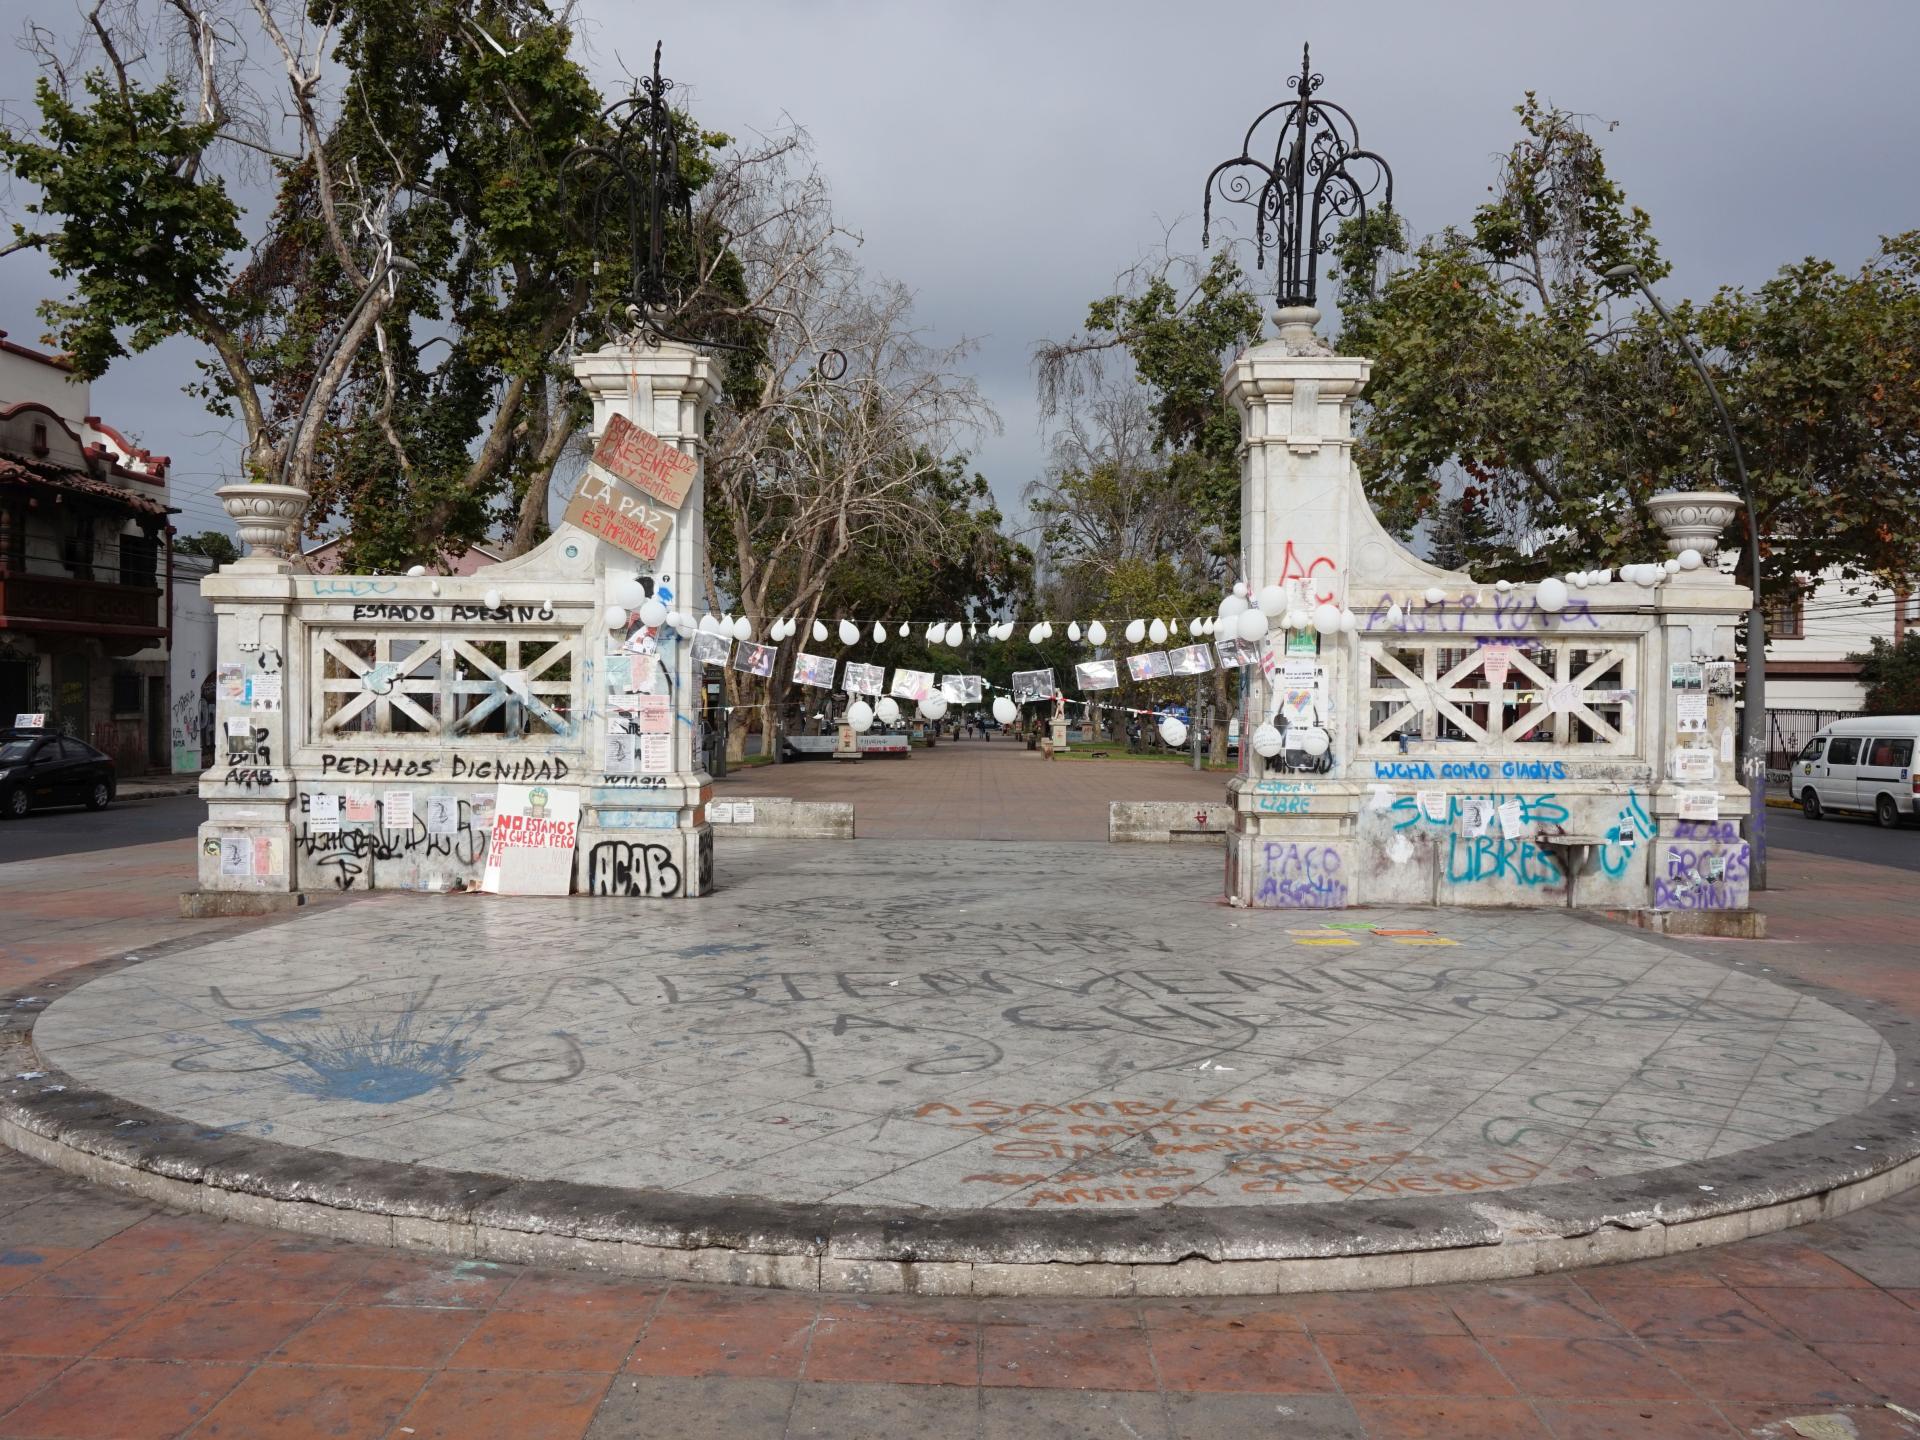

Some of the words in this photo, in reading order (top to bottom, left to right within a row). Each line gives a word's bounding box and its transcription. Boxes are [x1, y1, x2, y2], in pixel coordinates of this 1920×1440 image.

[604, 430, 673, 484] PRESENTE
[580, 475, 611, 505] LA
[619, 496, 661, 532] PAZ
[597, 504, 616, 520] SIN
[581, 510, 602, 529] ES
[602, 520, 657, 560] IMPUNIDAD
[353, 603, 435, 622] ESTADO
[451, 604, 554, 622] ASESINO
[322, 754, 435, 777] PEDIMOS
[451, 754, 570, 781] DIGNIDAD
[1375, 761, 1436, 780] LUCHA
[1441, 762, 1489, 780] COMO
[603, 775, 639, 788] YUTA
[497, 814, 524, 831] NO
[526, 818, 576, 836] ESTAMOS
[492, 827, 507, 842] EN
[509, 830, 546, 846] GUERRA
[549, 834, 576, 849] PERO
[589, 841, 682, 898] ACAB
[1263, 842, 1342, 875] PACO
[657, 967, 1630, 1004] BIENVENIDOS
[914, 1099, 1334, 1118] ASAMBLEAS
[992, 1139, 1116, 1161] SIN
